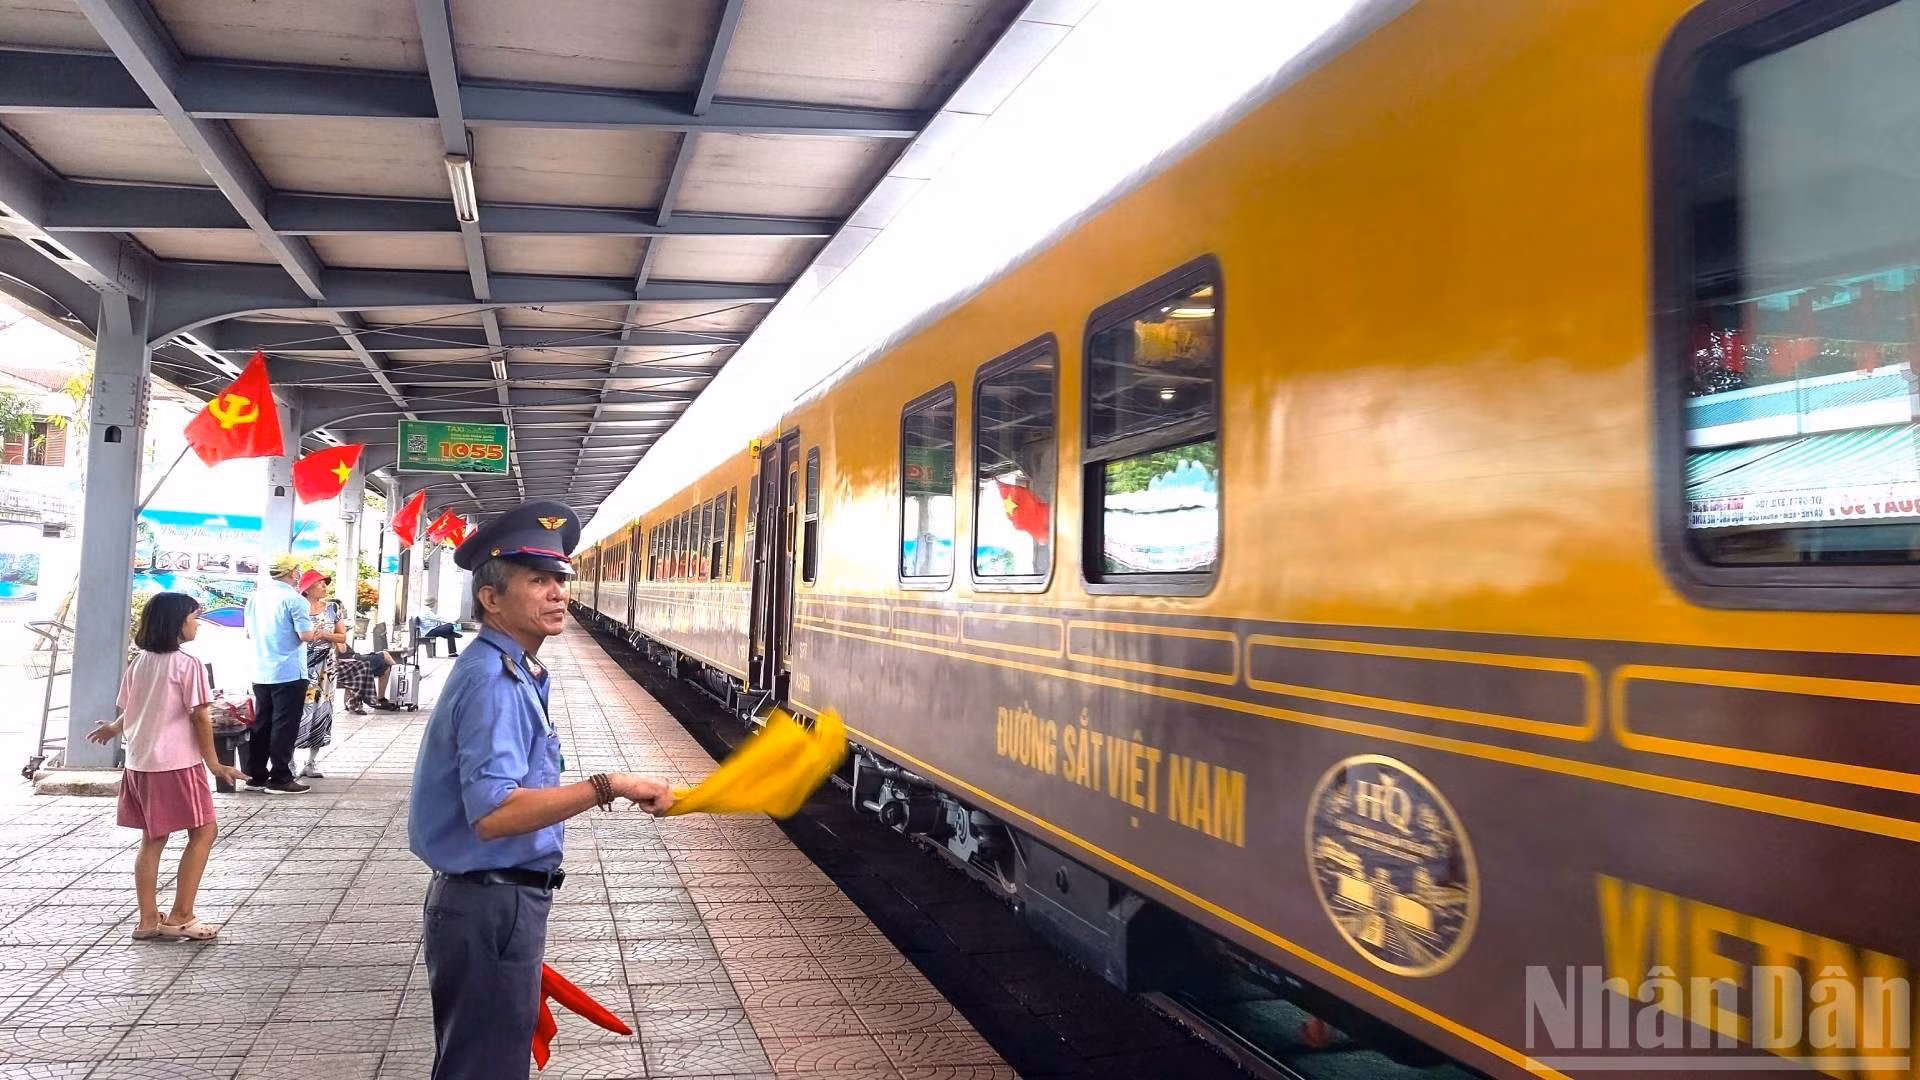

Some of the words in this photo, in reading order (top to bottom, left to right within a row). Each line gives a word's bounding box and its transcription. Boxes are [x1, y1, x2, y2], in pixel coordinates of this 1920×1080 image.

[439, 442, 504, 460] 1055
[996, 701, 1057, 776] ĐƯỜNG
[1063, 707, 1104, 792] SẮT
[1106, 729, 1162, 829] VIỆT
[1167, 752, 1247, 849] NAM
[1597, 871, 1920, 1080] VIETN
